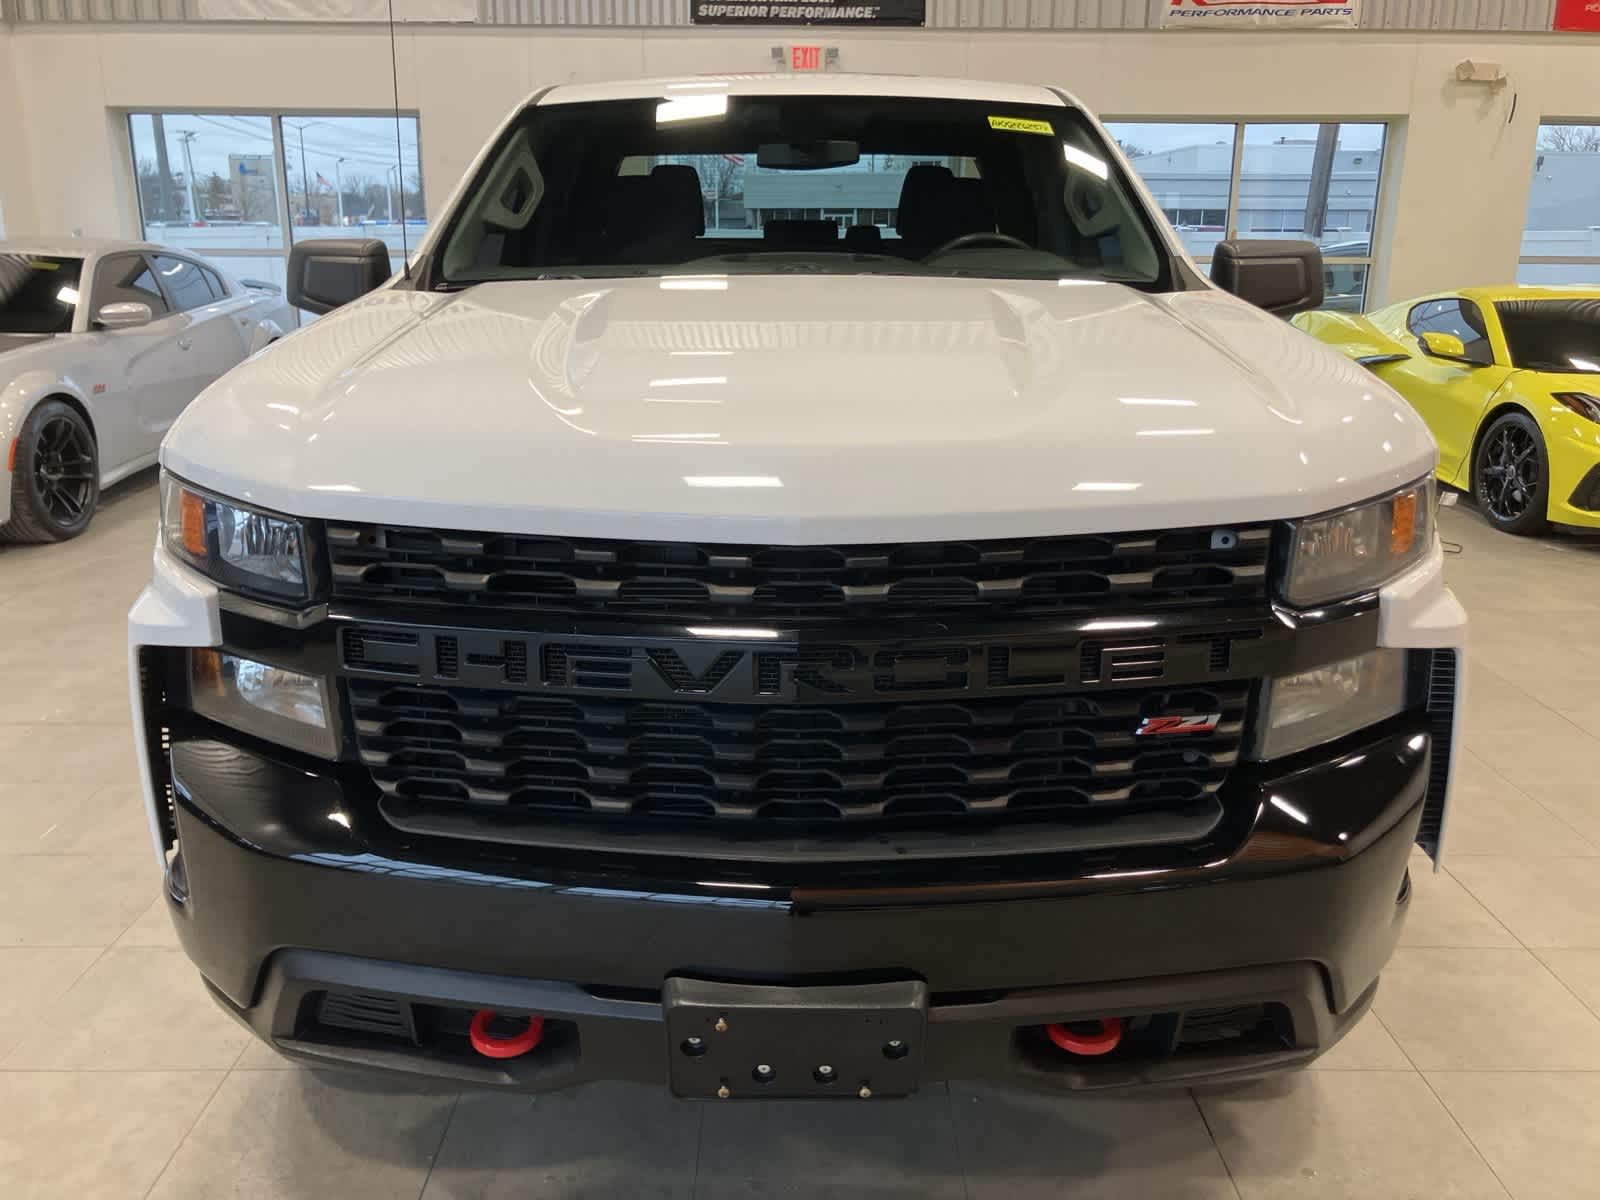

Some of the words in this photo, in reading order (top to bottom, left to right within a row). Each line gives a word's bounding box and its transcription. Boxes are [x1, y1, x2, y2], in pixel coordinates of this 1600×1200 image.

[698, 4, 768, 17] SUPERIOR
[1169, 8, 1297, 17] PERFORMANCE
[1300, 7, 1353, 16] PARTS
[792, 47, 820, 69] EXIT
[342, 626, 1264, 696] CHEVROLET
